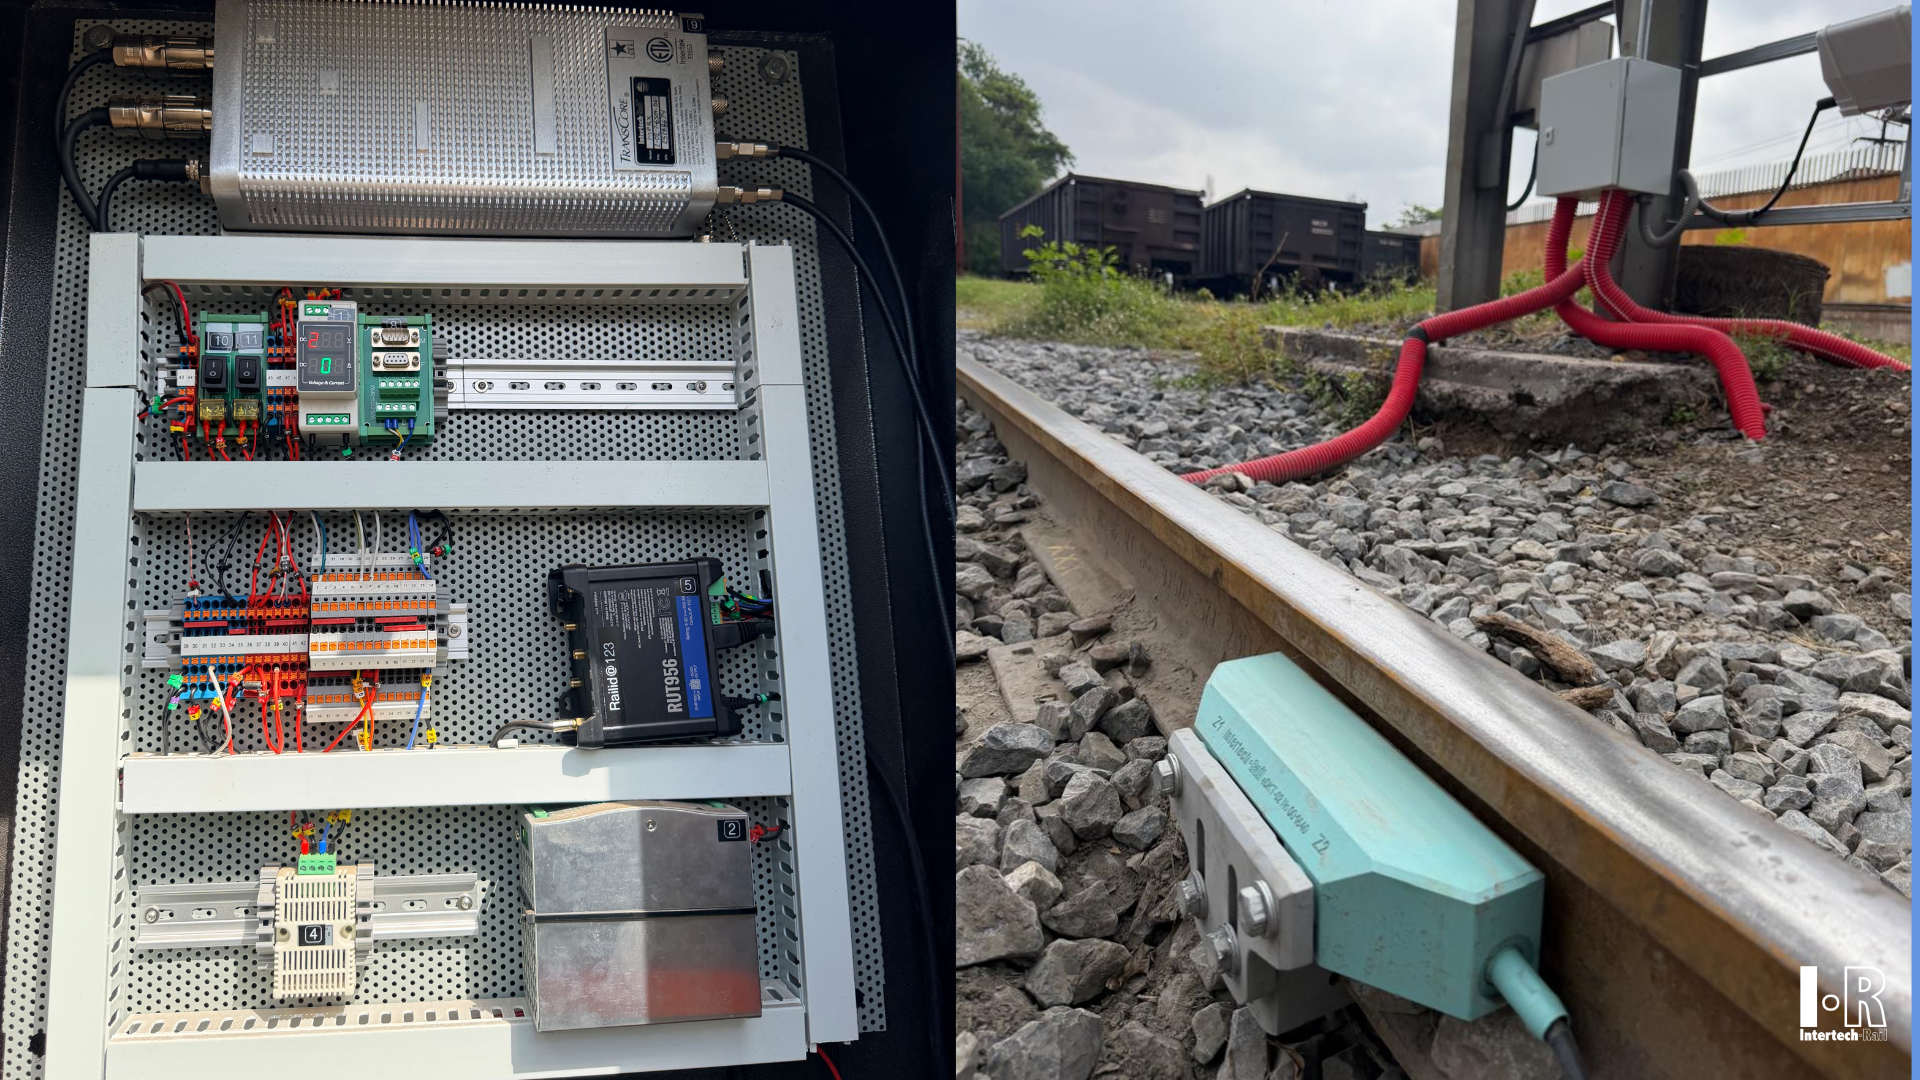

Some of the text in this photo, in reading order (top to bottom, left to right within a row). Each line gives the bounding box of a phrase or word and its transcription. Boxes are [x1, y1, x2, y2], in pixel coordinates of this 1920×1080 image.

[679, 38, 687, 65] Intertek
[215, 335, 229, 346] 10
[245, 334, 258, 345] 11
[603, 641, 621, 712] Railid@123
[661, 658, 684, 713] RUT956
[728, 823, 736, 836] 2
[1311, 832, 1331, 856] Z2
[309, 927, 318, 940] 4
